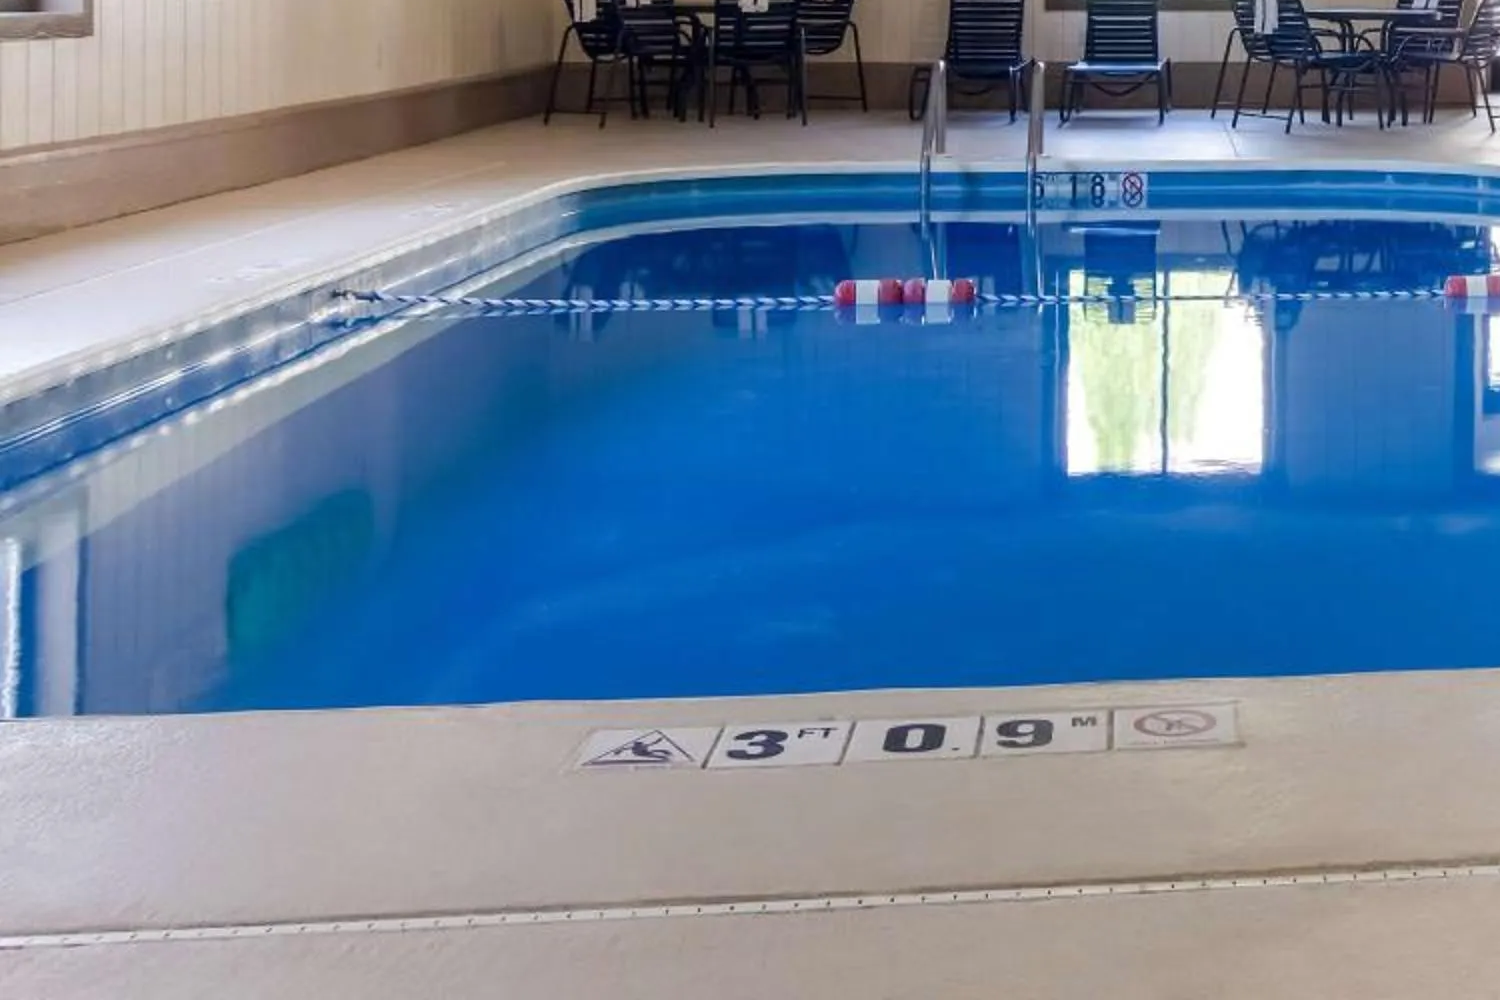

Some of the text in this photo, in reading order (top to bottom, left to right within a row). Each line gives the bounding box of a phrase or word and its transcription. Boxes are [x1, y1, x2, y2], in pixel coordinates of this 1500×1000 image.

[727, 729, 789, 760] 3
[797, 727, 839, 739] FT
[1071, 716, 1098, 728] M
